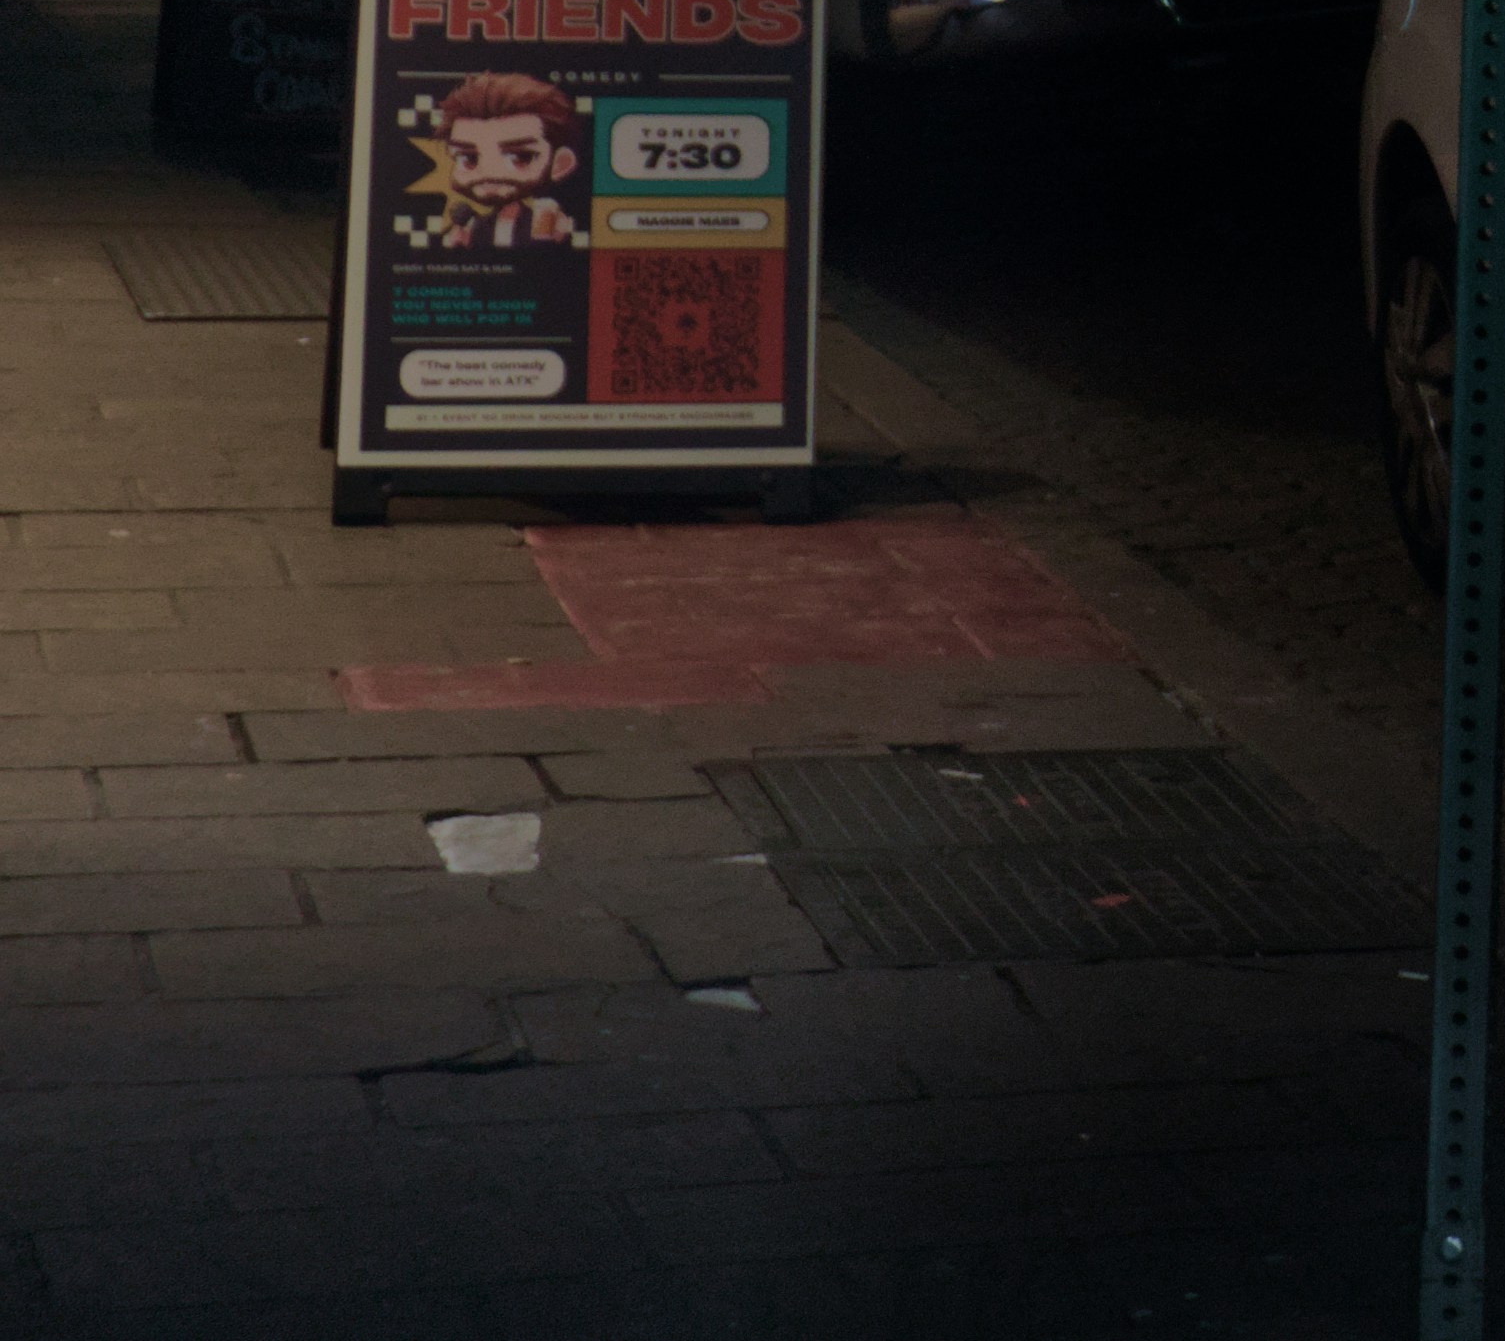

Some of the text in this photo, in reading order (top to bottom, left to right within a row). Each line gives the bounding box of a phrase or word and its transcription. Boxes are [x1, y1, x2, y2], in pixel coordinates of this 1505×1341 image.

[548, 70, 643, 84] COMEDY
[641, 127, 741, 139] TONIGHT
[638, 141, 742, 170] 7:30
[430, 299, 483, 311] NEVER
[456, 359, 486, 370] best
